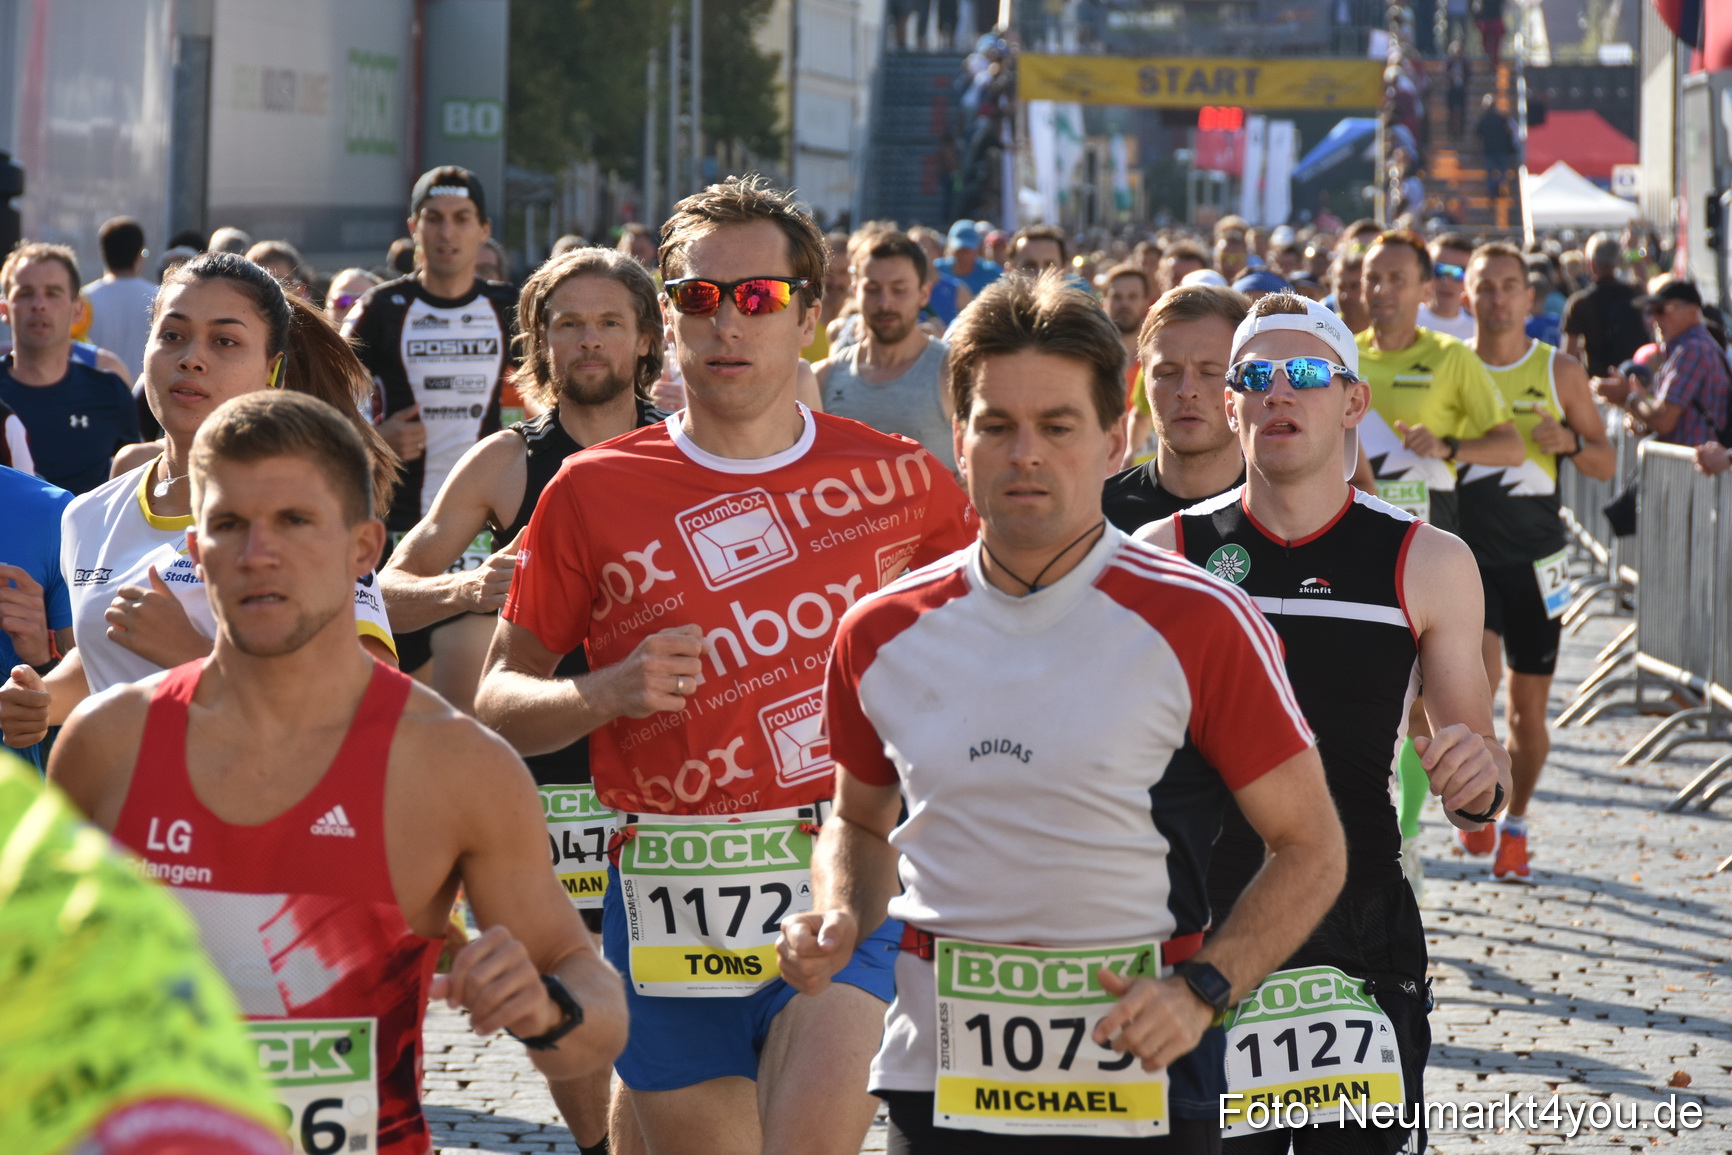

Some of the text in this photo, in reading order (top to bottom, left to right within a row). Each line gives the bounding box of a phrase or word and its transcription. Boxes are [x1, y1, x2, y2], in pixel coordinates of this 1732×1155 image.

[1138, 66, 1260, 96] START
[684, 494, 765, 532] raumbox
[810, 513, 899, 552] schenken
[75, 568, 113, 581] BOCK
[1299, 586, 1332, 594] skinfit
[619, 592, 685, 635] outdoor
[706, 666, 788, 709] wohnen
[969, 739, 1033, 764] ADIDAS
[147, 818, 192, 853] LG
[310, 823, 356, 837] adidas
[633, 826, 799, 869] BOCK
[648, 882, 793, 938] 1172
[685, 953, 763, 976] TOMS
[952, 949, 1137, 999] BOCK
[1235, 1019, 1374, 1079] 1127
[975, 1087, 1128, 1113] MICHAEL
